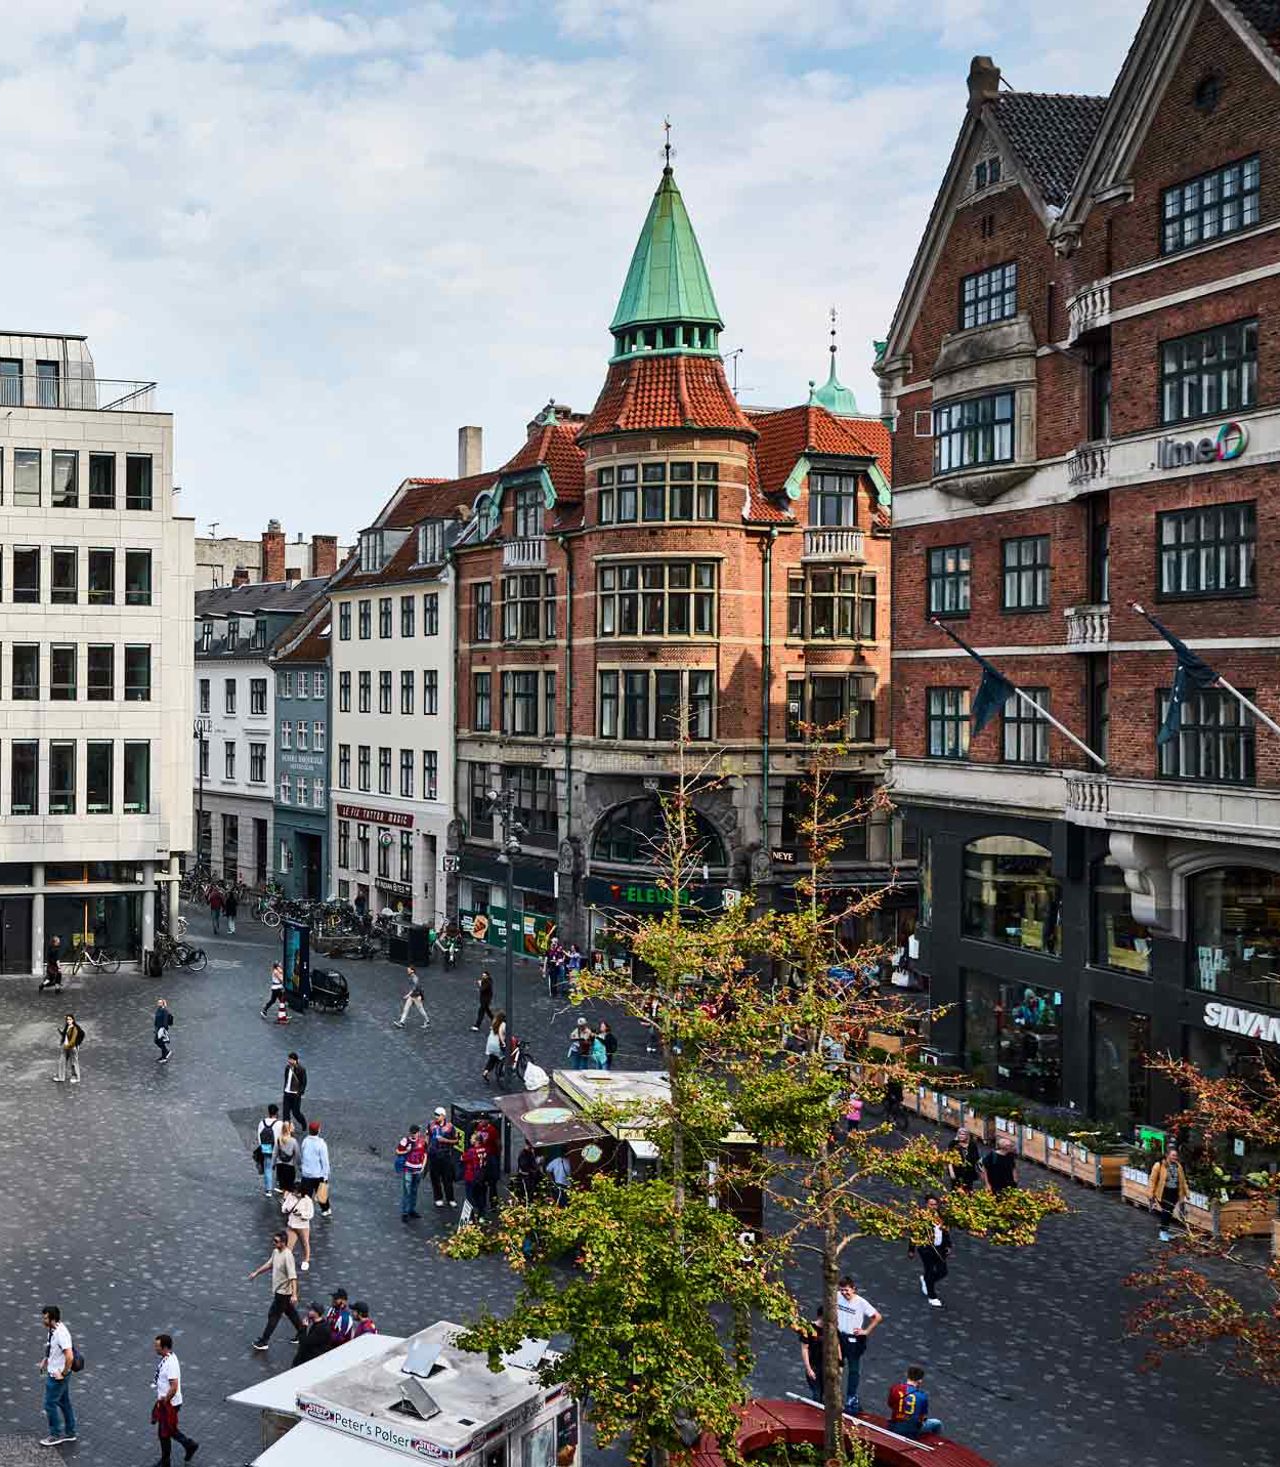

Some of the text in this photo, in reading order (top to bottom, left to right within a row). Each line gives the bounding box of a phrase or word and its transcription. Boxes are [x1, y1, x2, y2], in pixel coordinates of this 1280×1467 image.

[772, 851, 794, 862] NEYE
[334, 1412, 372, 1435] Peter's
[375, 1425, 410, 1448] Pølser
